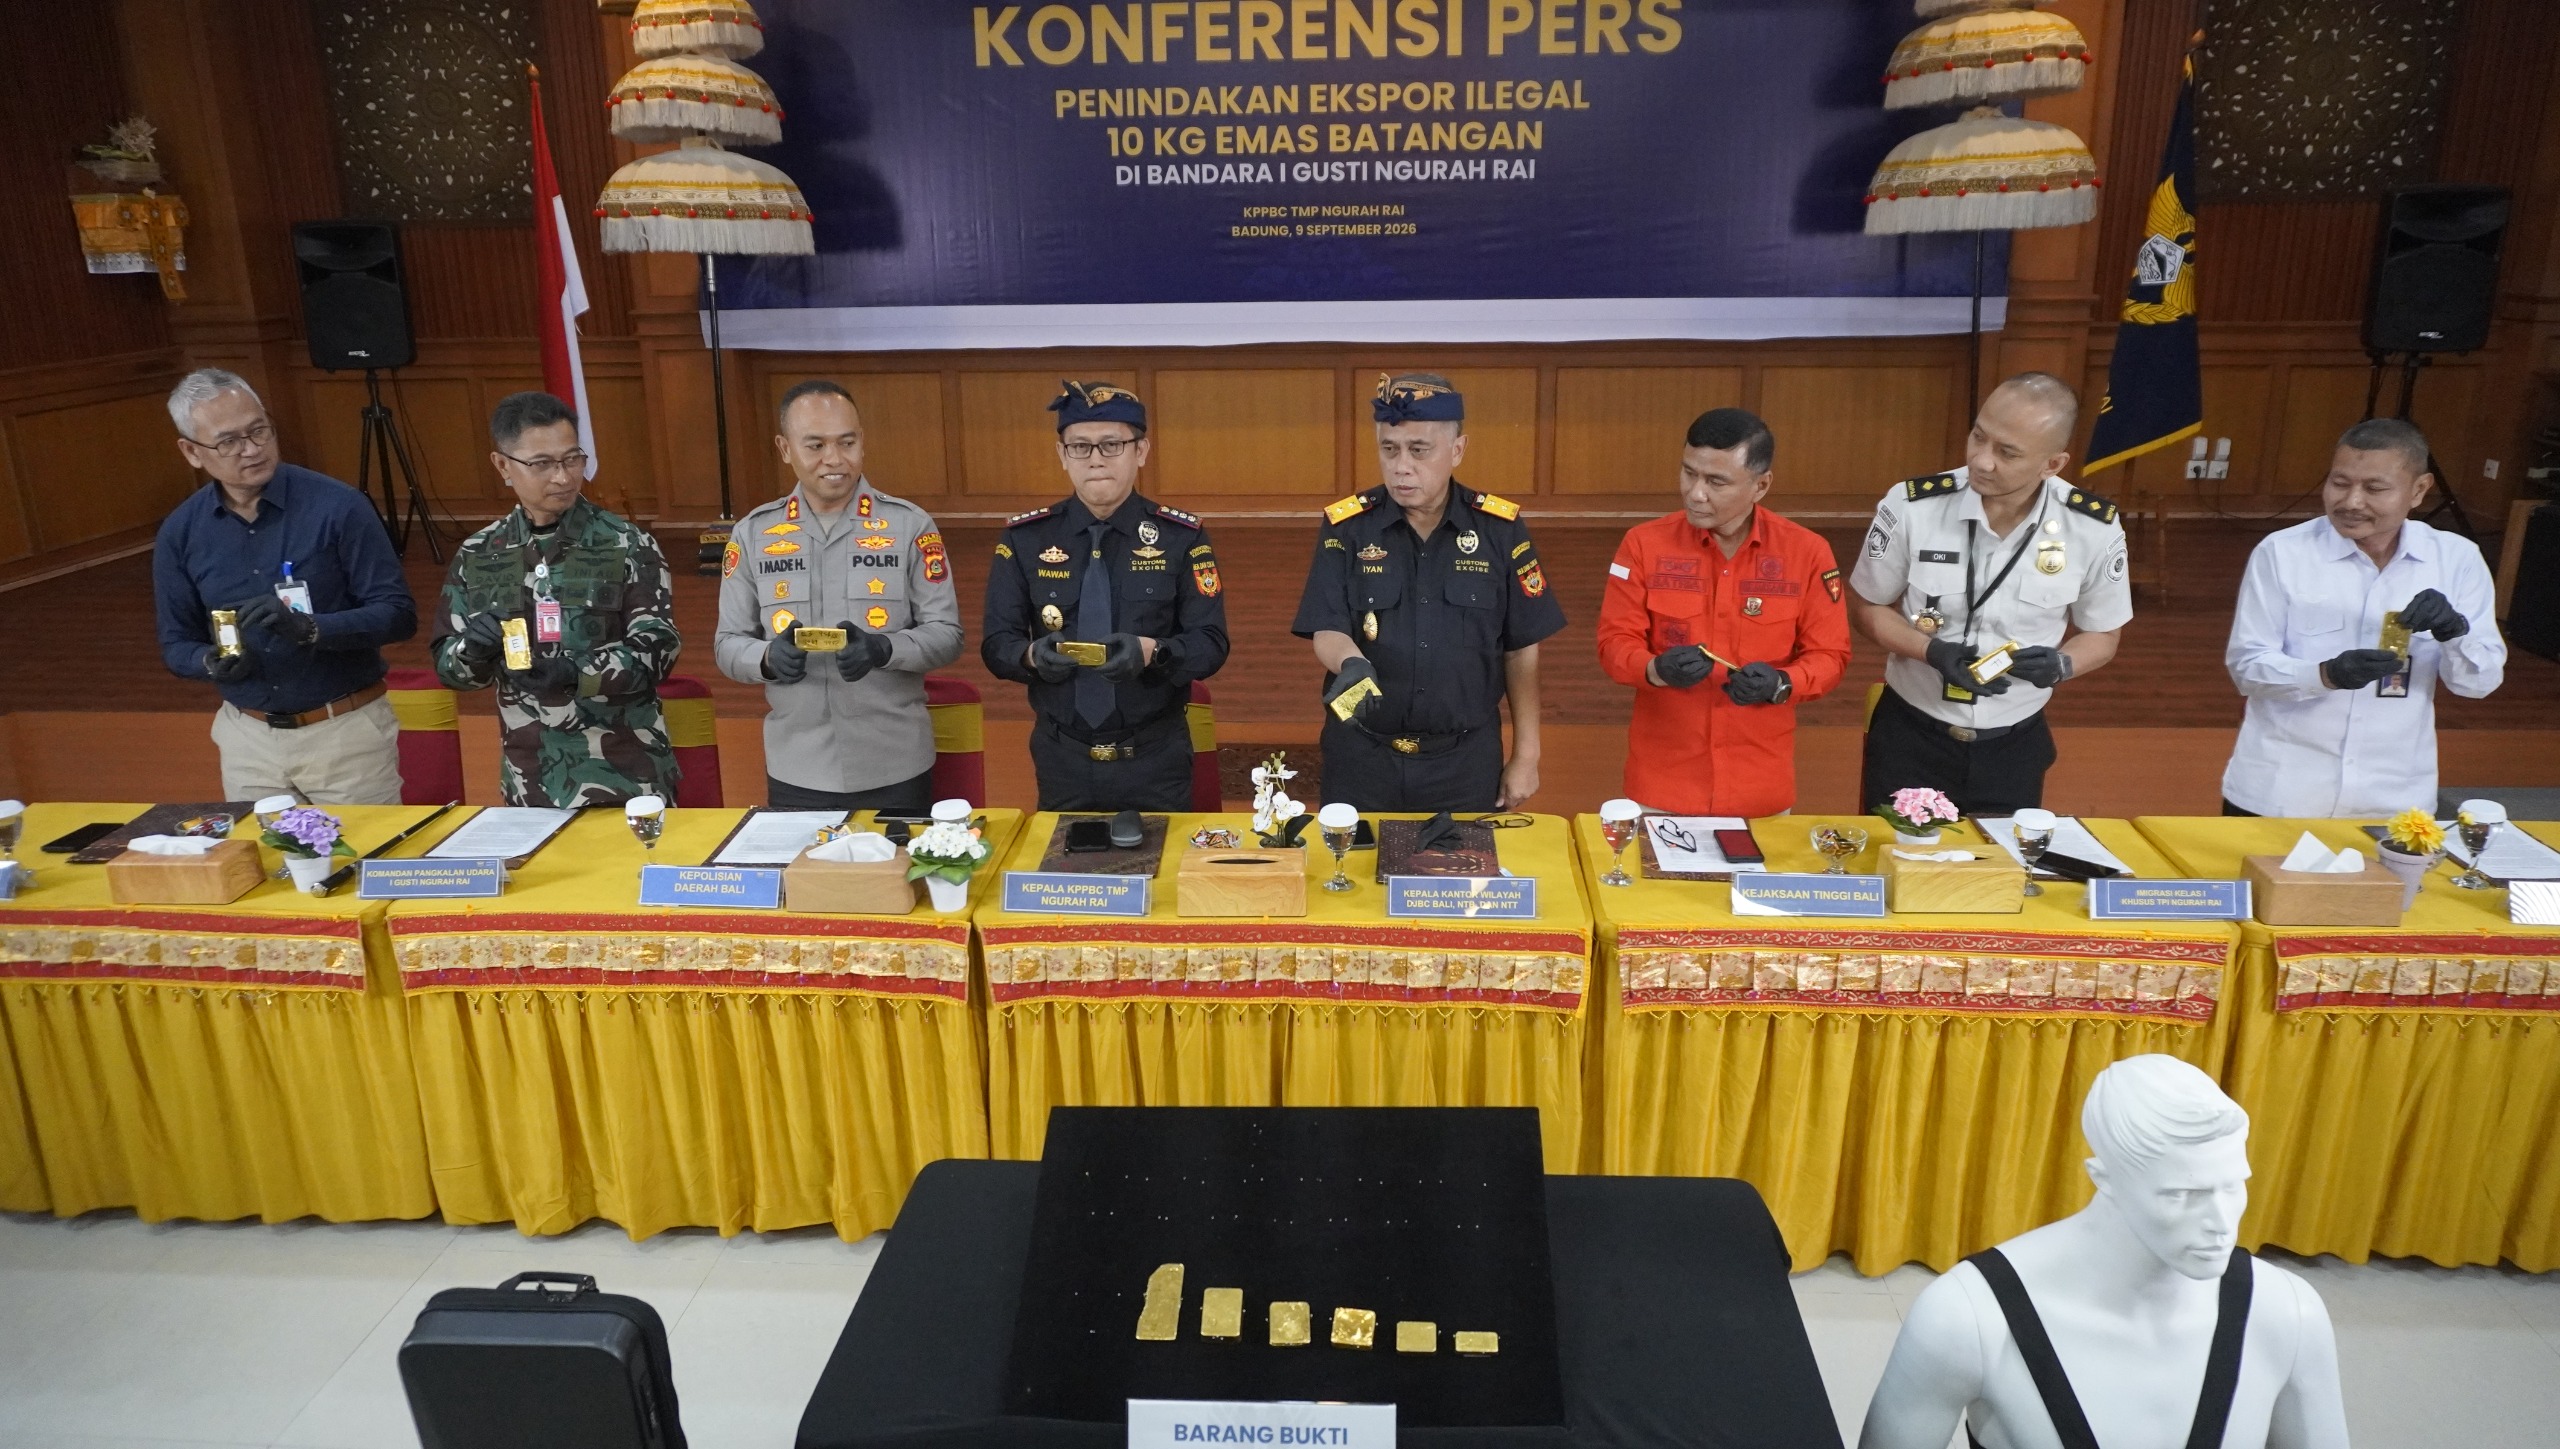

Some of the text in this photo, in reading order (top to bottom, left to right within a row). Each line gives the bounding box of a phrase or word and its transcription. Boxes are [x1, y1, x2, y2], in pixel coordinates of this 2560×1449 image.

[973, 0, 1684, 67] KONFERENSI PERS
[1055, 79, 1590, 118] PENINDAKAN EKSPOR ILEGAL
[1107, 121, 1543, 157] 10 KG EMAS BATANGAN
[1115, 159, 1537, 186] DI BANDARA I GUSTI NGURAH RAI
[1243, 204, 1405, 219] KPPBC TMP NGURAH RAI
[1231, 223, 1417, 238] BADUNG, 9 SEPTEMBER 2026
[852, 554, 899, 568] POLRI
[1933, 553, 1946, 561] OKI
[759, 557, 806, 574] I MADE H.
[1455, 559, 1490, 567] CUSTOMS
[1038, 569, 1070, 579] WAWAN
[1363, 565, 1383, 574] IYAN
[1456, 565, 1489, 573] EXCISE
[367, 870, 413, 878] KOMANDAN
[414, 869, 466, 877] PANGKALAN
[680, 871, 742, 881] KEPOLISIAN
[456, 877, 470, 885] RAI
[674, 883, 745, 894] DAERAH BALI
[1022, 883, 1129, 895] KEPALA KPPBC TMP
[2136, 889, 2173, 897] IMIGRASI
[1403, 890, 1521, 899] KEPALA KANTOR WILAYAH
[1742, 888, 1879, 901] KEJAKSAAN TINGGI BALI
[1041, 896, 1108, 907] NGURAH RAI
[1406, 900, 1430, 908] DJBC
[1432, 900, 1455, 909] BALI,
[1480, 901, 1499, 909] DAN
[1501, 901, 1518, 909] NTT
[2121, 898, 2155, 906] KHUSUS
[2208, 899, 2222, 907] RAI
[1173, 1424, 1348, 1446] BARANG BUKTI
